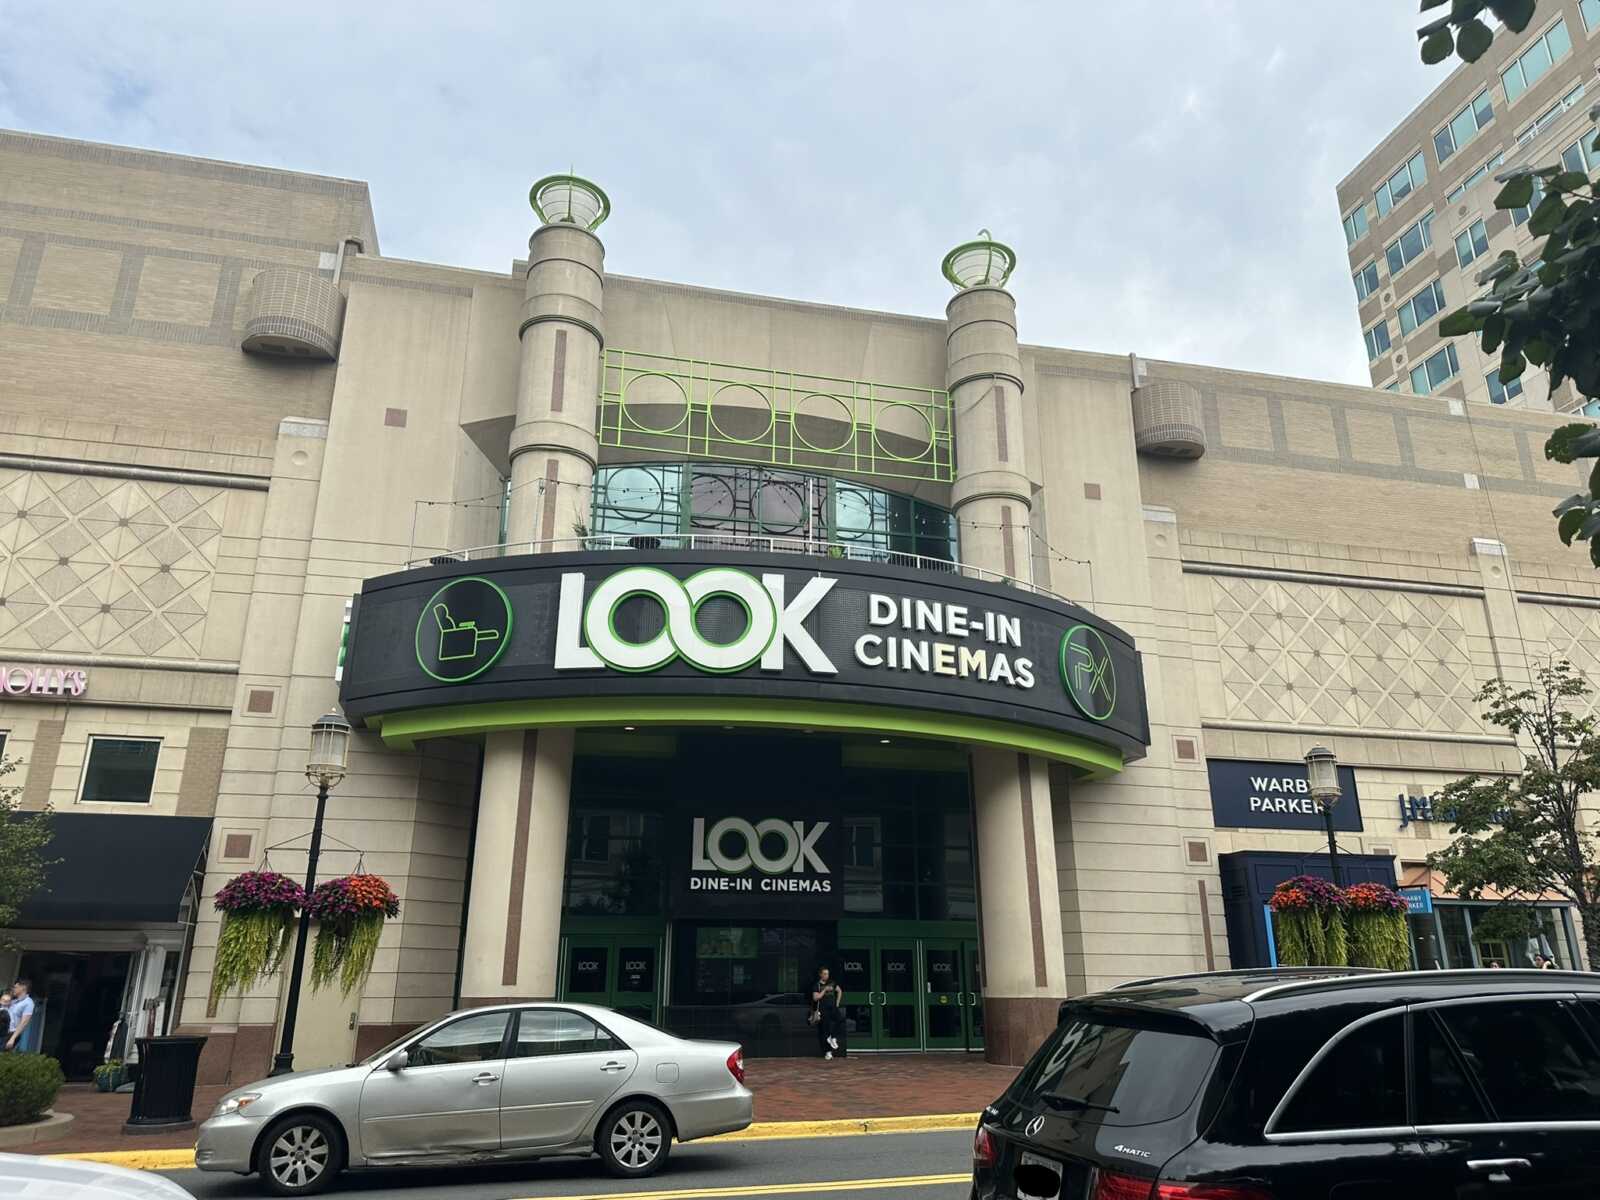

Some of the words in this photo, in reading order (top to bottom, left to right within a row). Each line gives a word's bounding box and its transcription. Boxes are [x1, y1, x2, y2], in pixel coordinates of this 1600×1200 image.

[552, 566, 839, 675] LOOK
[868, 594, 1023, 649] DINE-IN
[854, 633, 1036, 691] CINEMAS
[1249, 776, 1312, 794] WARB
[690, 816, 831, 875] LOOK
[690, 877, 753, 891] DINE-IN
[760, 878, 832, 893] CINEMAS
[577, 961, 600, 971] LOOK
[625, 961, 647, 971] LOOK
[844, 961, 863, 972] LOOK
[887, 961, 906, 972] LOOK
[933, 962, 952, 972] LOOK
